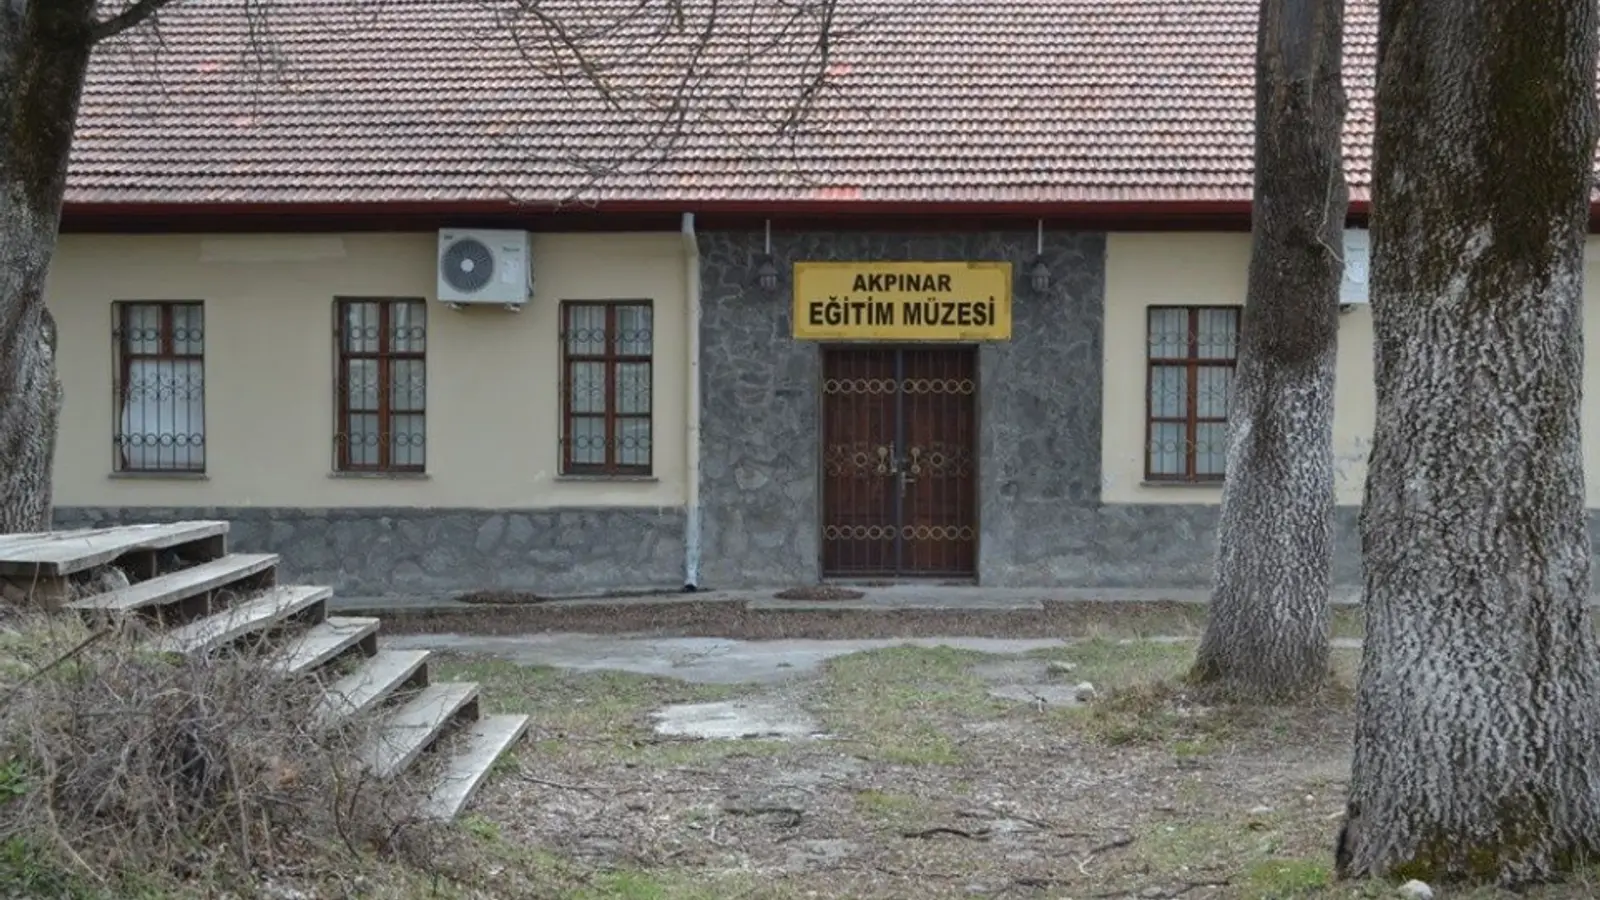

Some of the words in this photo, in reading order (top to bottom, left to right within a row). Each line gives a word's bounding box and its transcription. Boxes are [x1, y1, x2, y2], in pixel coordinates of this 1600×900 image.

[852, 273, 952, 292] AKPINAR
[809, 295, 894, 326] EĞİTİM
[902, 296, 995, 326] MÜZESİ
